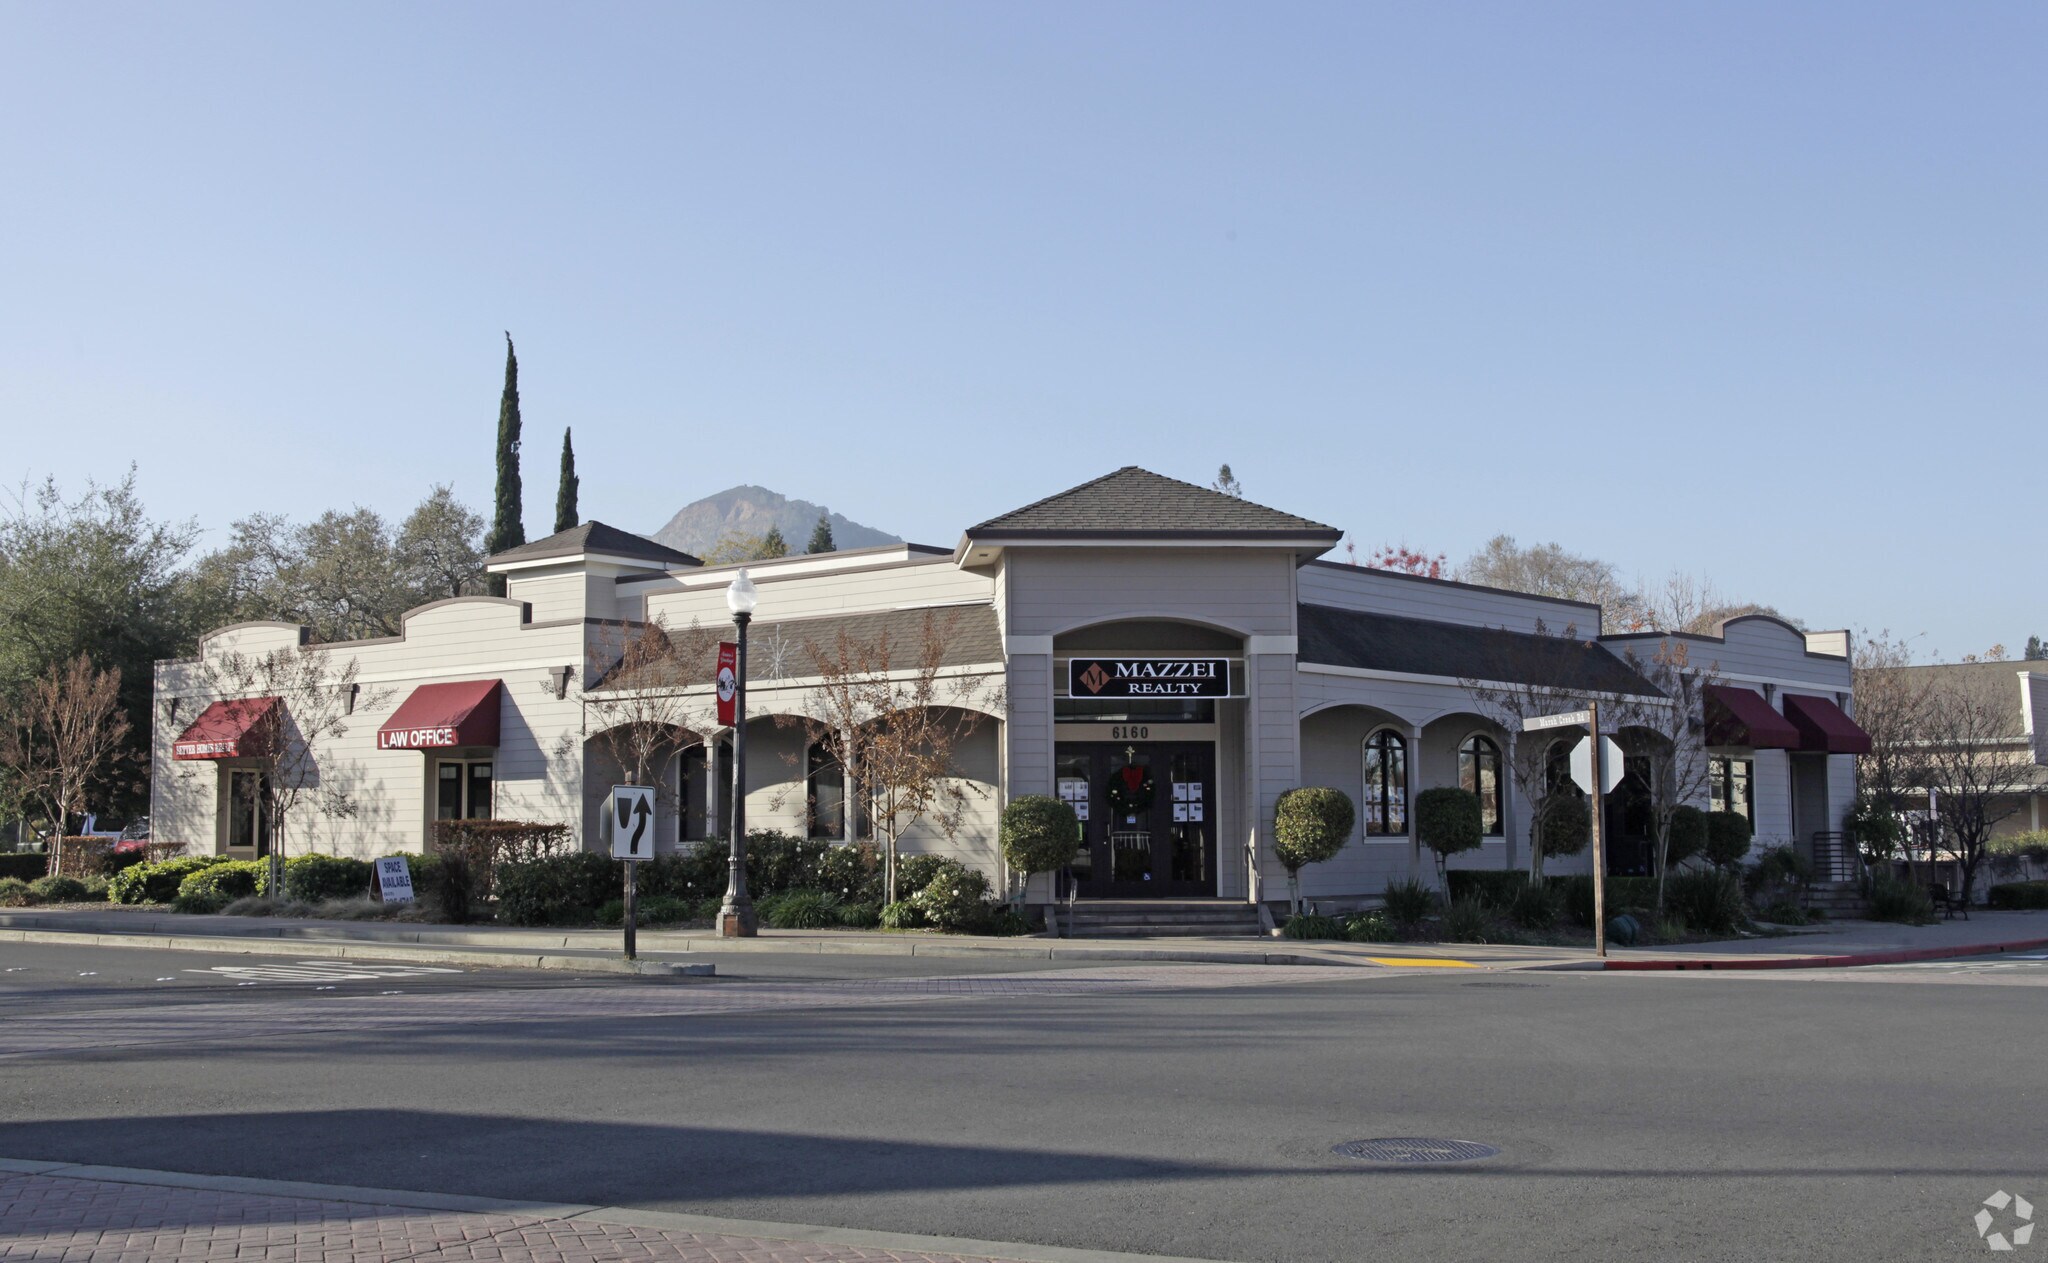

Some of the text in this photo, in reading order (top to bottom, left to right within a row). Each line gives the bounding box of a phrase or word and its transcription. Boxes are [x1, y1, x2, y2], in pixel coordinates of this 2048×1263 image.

[1115, 662, 1216, 678] MAZZEI
[1086, 670, 1103, 686] M
[1128, 683, 1202, 694] REALTY
[1539, 716, 1558, 727] Marsh
[1558, 714, 1576, 725] Creek
[1576, 712, 1585, 722] Rd
[381, 728, 453, 748] LAW OFFICE
[1112, 726, 1149, 739] 6160
[384, 861, 402, 873] SPACE
[382, 875, 411, 889] AVAILABLE
